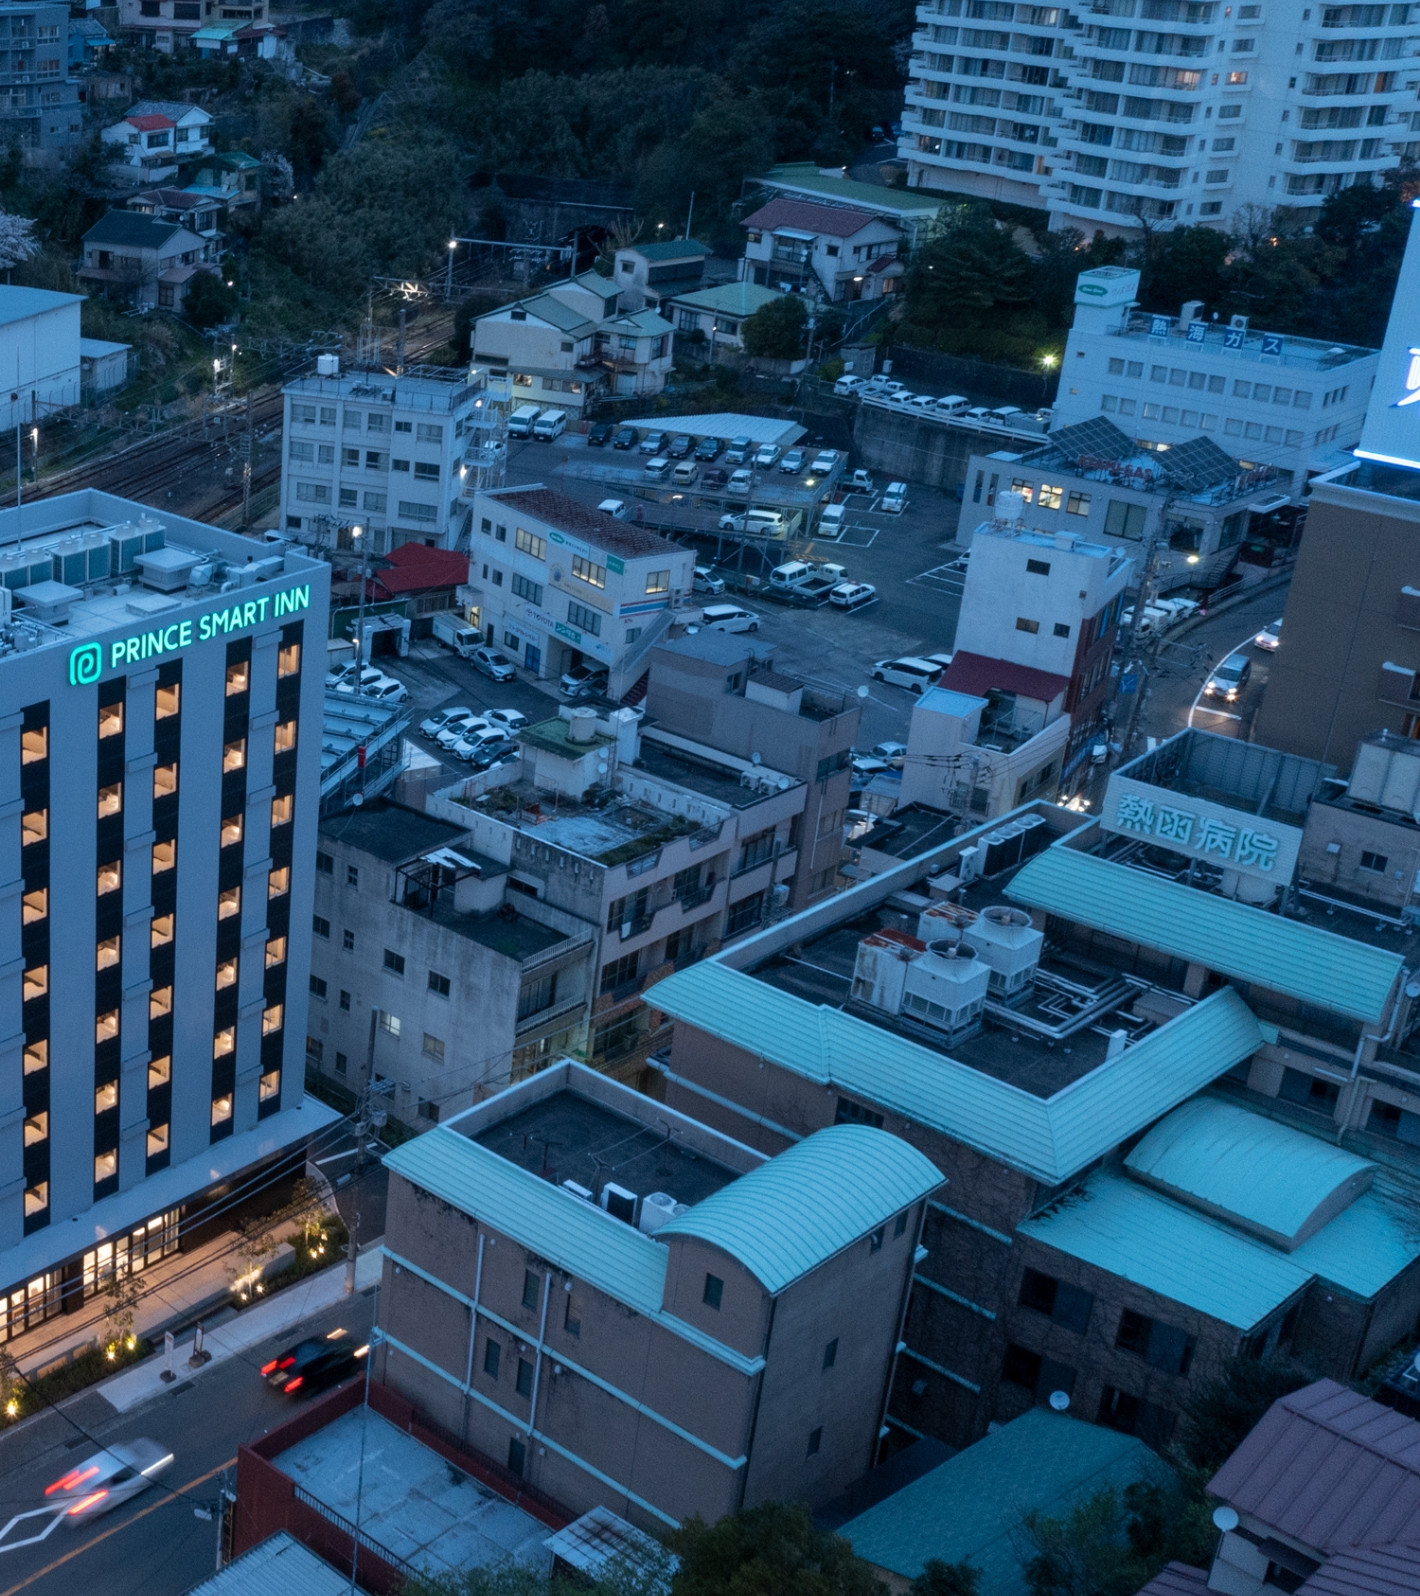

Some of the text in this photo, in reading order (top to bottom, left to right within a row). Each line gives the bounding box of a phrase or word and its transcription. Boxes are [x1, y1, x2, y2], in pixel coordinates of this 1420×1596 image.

[1150, 317, 1281, 354] 熱海ガス
[111, 584, 310, 669] PRINCE SMART INN
[1117, 793, 1279, 872] 熱函病院
